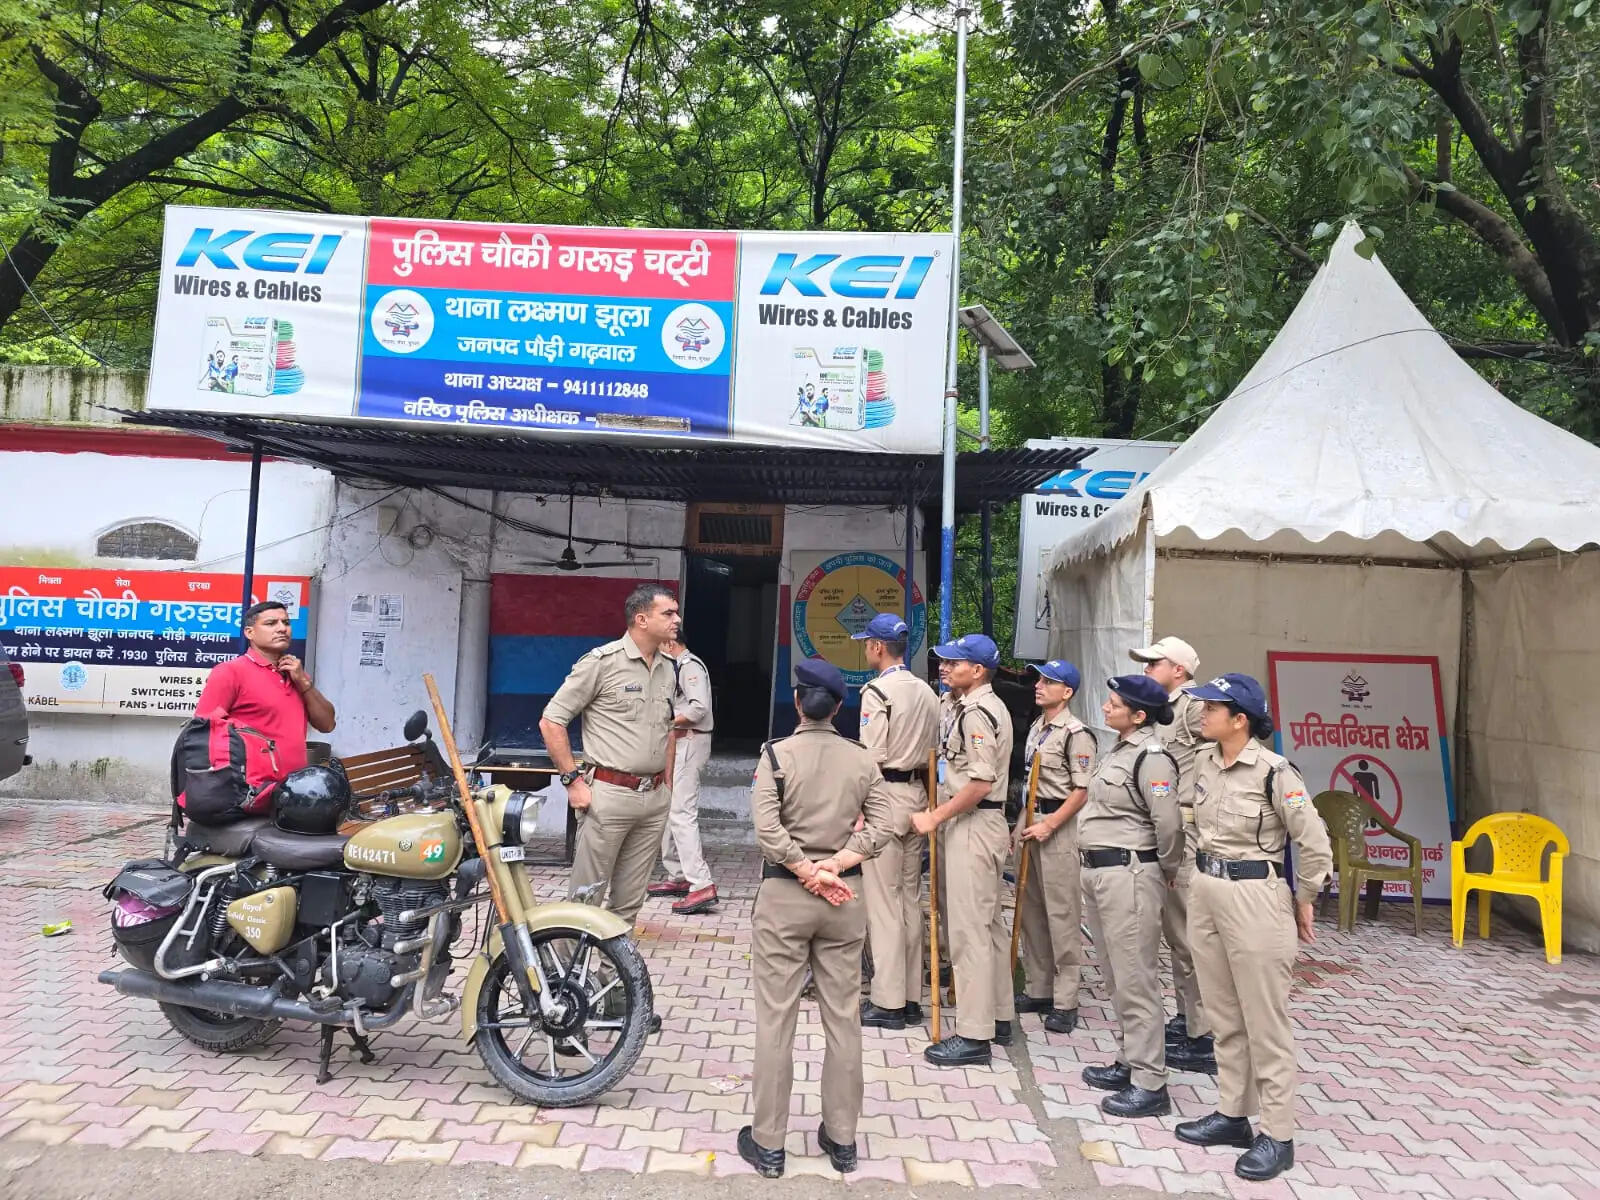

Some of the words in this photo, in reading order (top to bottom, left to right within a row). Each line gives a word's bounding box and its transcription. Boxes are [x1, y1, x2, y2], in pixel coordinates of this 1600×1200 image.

[176, 228, 343, 275] KEI
[393, 229, 474, 277] पुलिस
[480, 231, 552, 270] चौकी
[174, 274, 232, 297] Wires
[235, 281, 249, 299] &
[254, 279, 322, 303] Cables
[760, 252, 935, 300] KEI
[445, 297, 502, 320] थाना
[508, 299, 588, 325] लक्ष्मण
[594, 303, 652, 337] झूला
[759, 304, 819, 326] Wires
[823, 309, 837, 328] &
[842, 306, 913, 330] Cables
[457, 335, 520, 356] जनपद
[525, 334, 564, 363] पौड़ी
[570, 342, 637, 365] गढ़वाल
[444, 372, 484, 389] थाना
[488, 375, 543, 392] अध्यक्ष
[563, 379, 649, 398] 9411112848
[404, 396, 453, 417] वरिष्ठ
[456, 399, 507, 423] पुलिस
[511, 403, 581, 425] अधीक्षक
[1036, 501, 1077, 517] Wires
[1081, 505, 1090, 518] &
[115, 577, 130, 587] सेवा
[74, 587, 140, 620] चौकी
[14, 626, 42, 636] थाना
[45, 627, 84, 637] लक्ष्मण
[88, 628, 113, 642] झूला
[118, 629, 154, 640] जनपद
[190, 631, 230, 644] गढ़वाल
[21, 642, 42, 657] होने
[44, 647, 61, 657] पर
[63, 647, 93, 659] डायल
[96, 645, 115, 659] करें
[155, 647, 188, 665] पुलिस
[131, 688, 185, 698] SWITCHES
[160, 676, 192, 685] WIRES
[195, 677, 202, 685] &
[119, 700, 147, 709] FANS
[158, 701, 198, 711] LIGHTIN
[1290, 712, 1390, 752] प्रतिबन्धित
[1396, 716, 1430, 750] क्षेत्र
[423, 844, 443, 859] 49
[245, 926, 261, 939] 350
